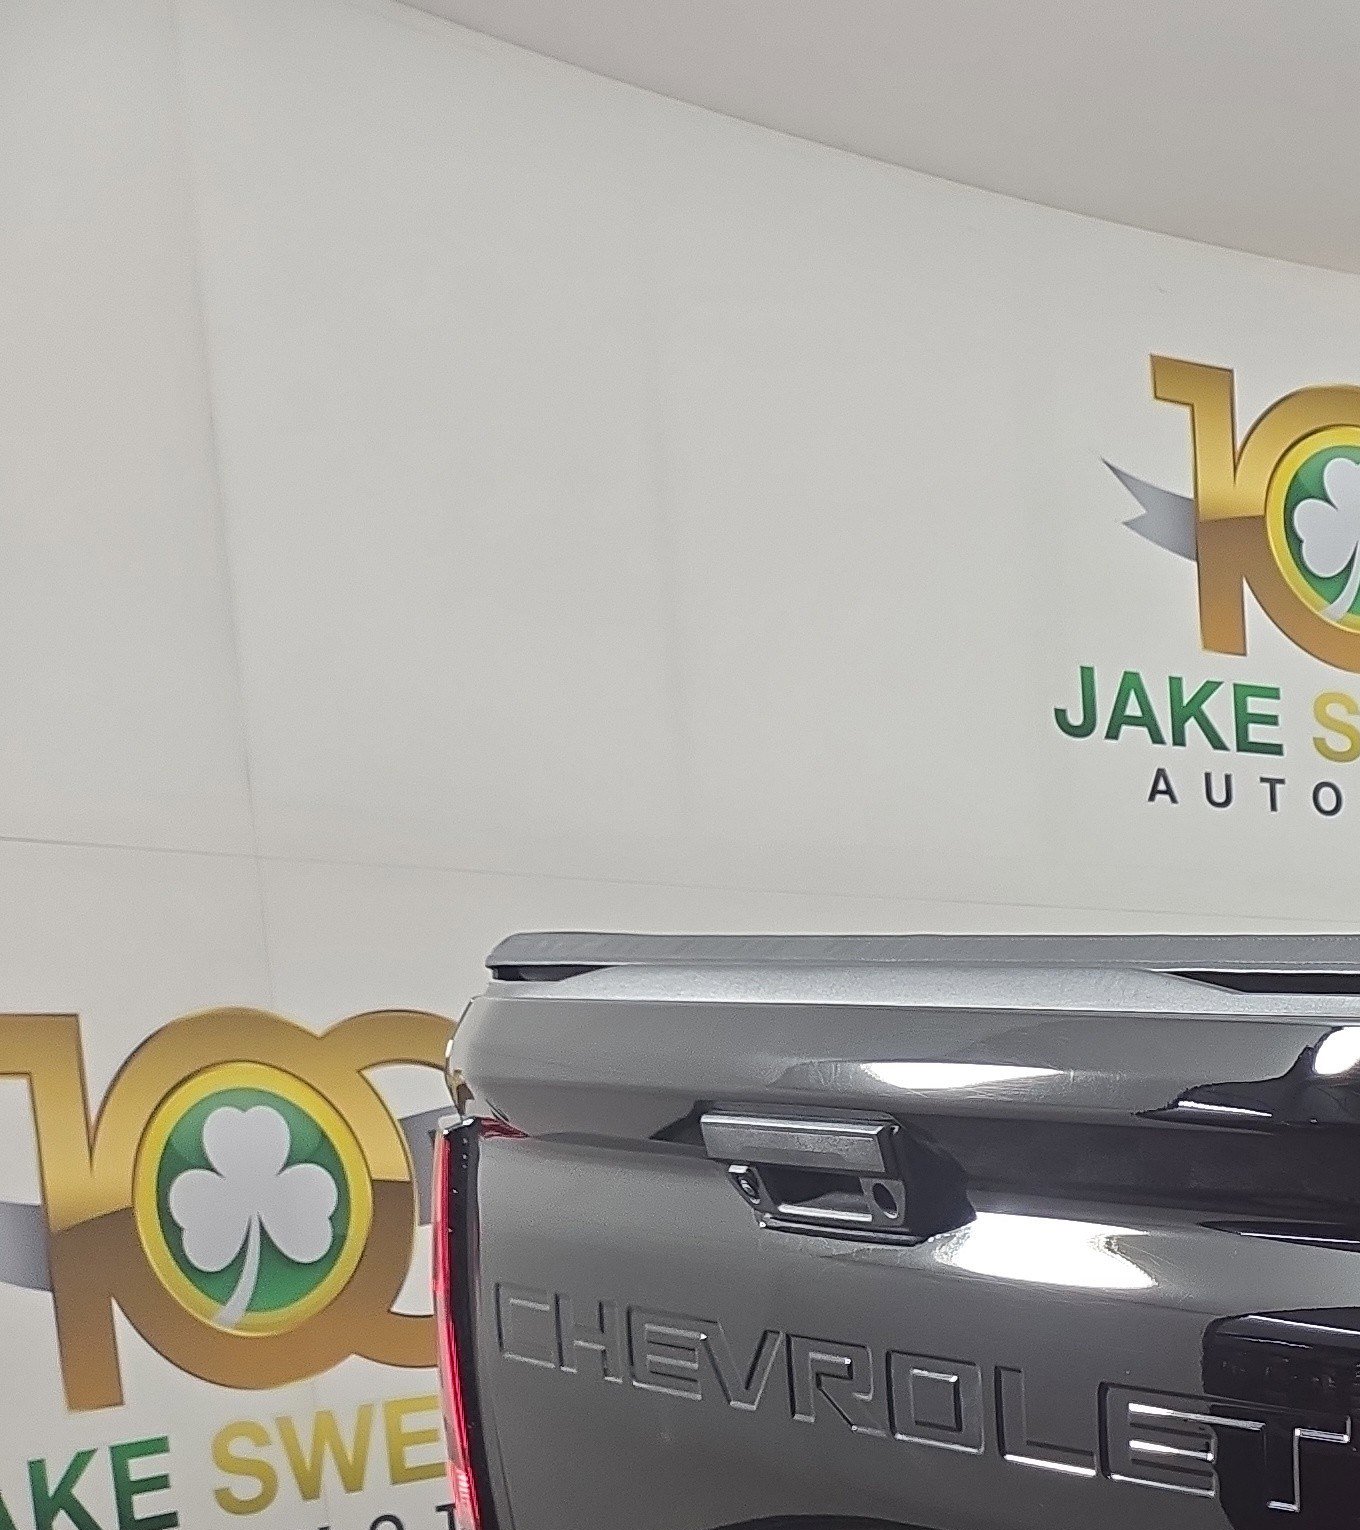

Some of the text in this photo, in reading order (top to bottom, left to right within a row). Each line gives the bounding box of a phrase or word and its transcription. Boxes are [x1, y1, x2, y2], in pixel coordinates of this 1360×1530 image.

[1053, 665, 1285, 757] JAKE
[210, 1394, 448, 1518] SWE
[494, 1282, 1352, 1512] CHEVROLET
